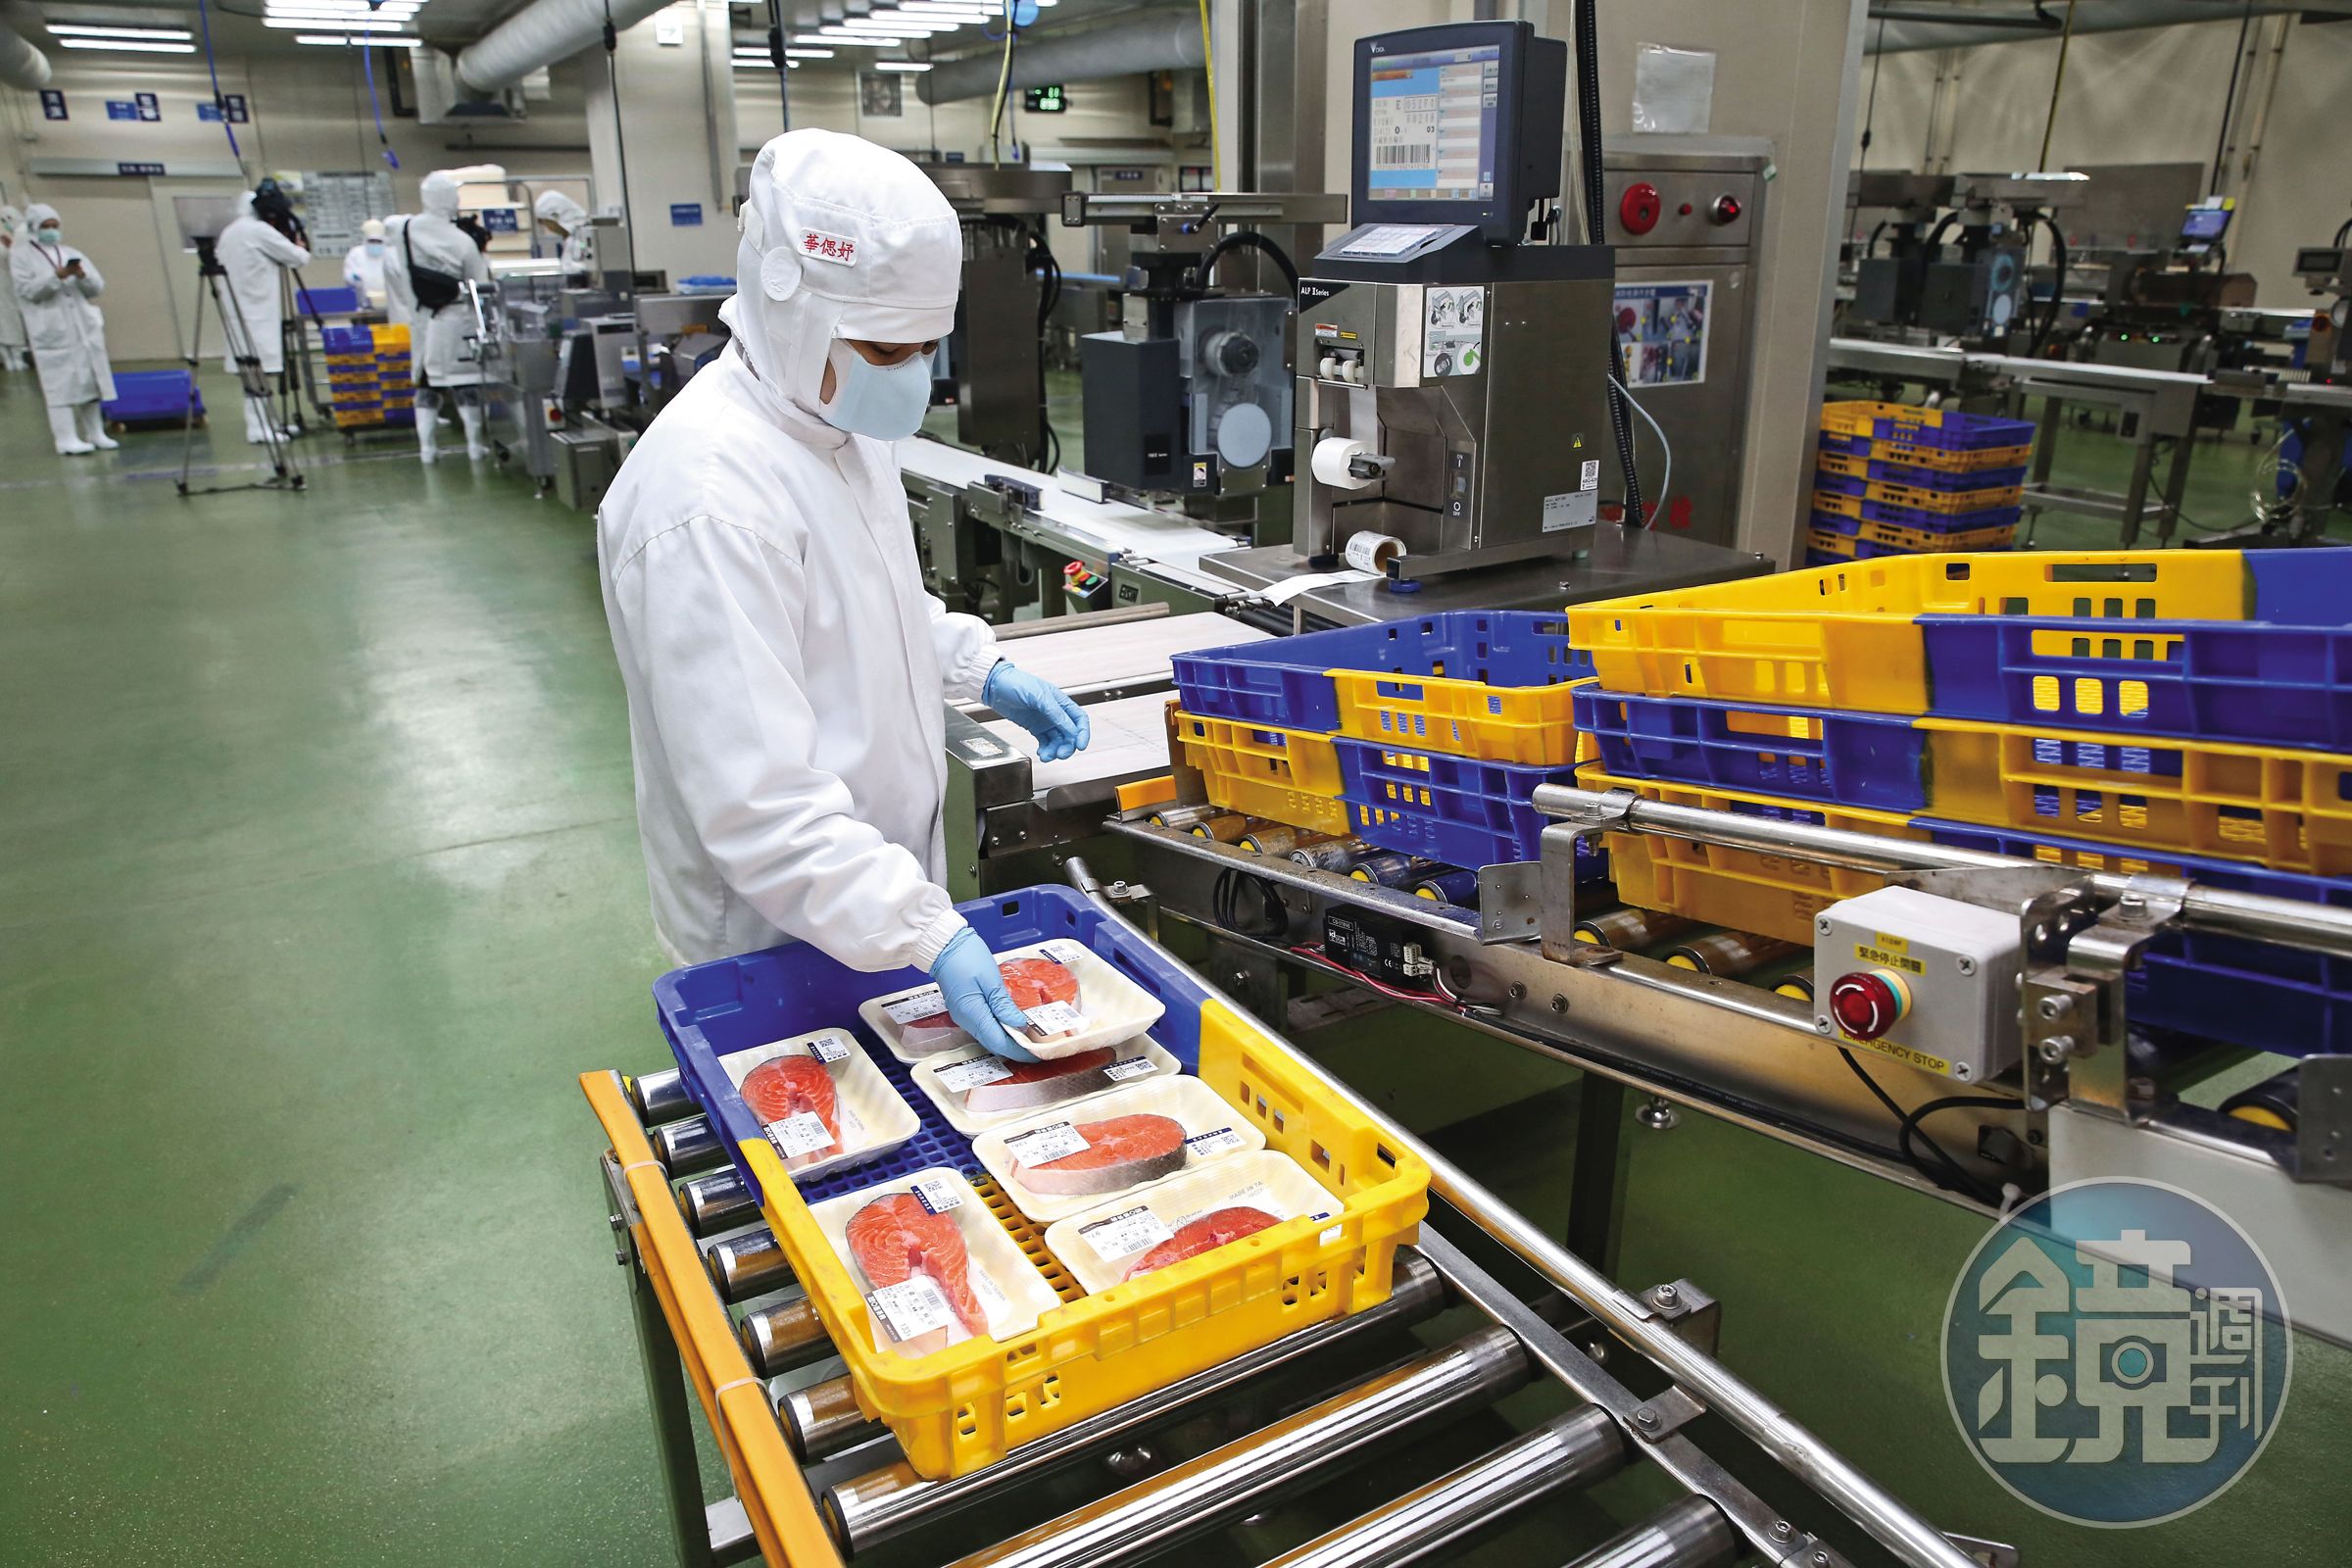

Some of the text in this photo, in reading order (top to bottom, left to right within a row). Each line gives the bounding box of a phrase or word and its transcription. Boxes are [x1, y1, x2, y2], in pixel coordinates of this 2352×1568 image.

[804, 234, 854, 262] 華偲妤
[1300, 286, 1311, 295] ALP
[1913, 1053, 1944, 1070] STOP
